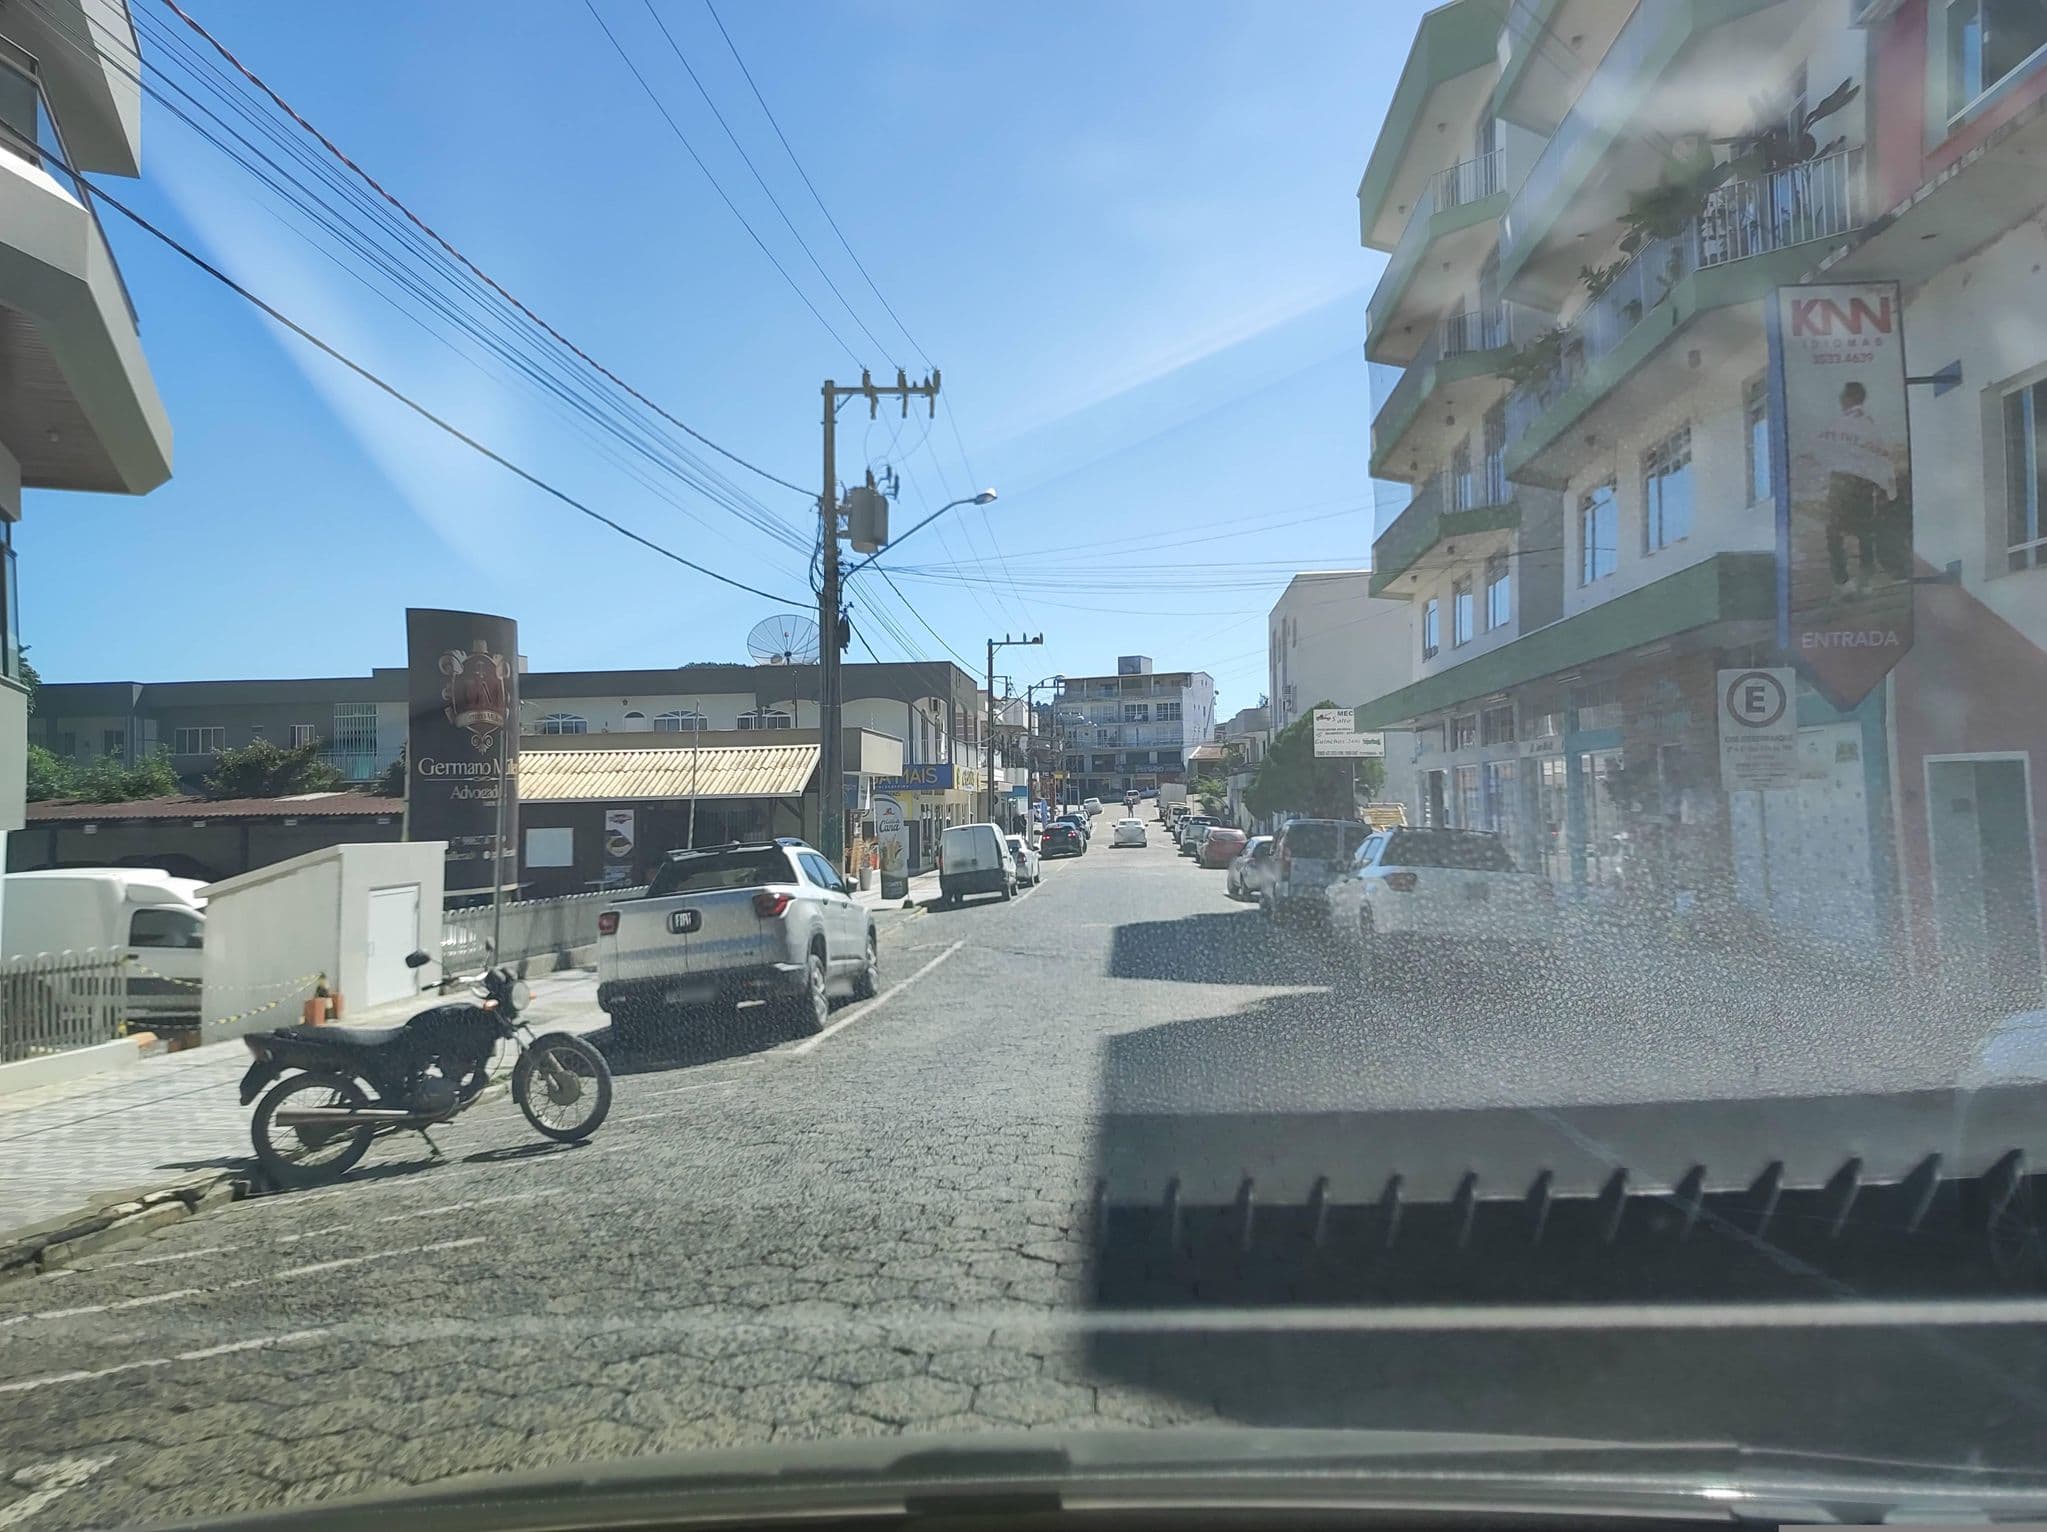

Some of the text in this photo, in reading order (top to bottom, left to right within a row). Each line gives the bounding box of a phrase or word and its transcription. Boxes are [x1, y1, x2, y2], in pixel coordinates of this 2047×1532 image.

[1791, 297, 1893, 336] KNN
[1802, 337, 1884, 350] IDIOMAS
[1802, 631, 1899, 648] ENTRADA
[1745, 686, 1766, 713] E
[418, 757, 491, 775] Germano
[674, 912, 691, 928] FIAT
